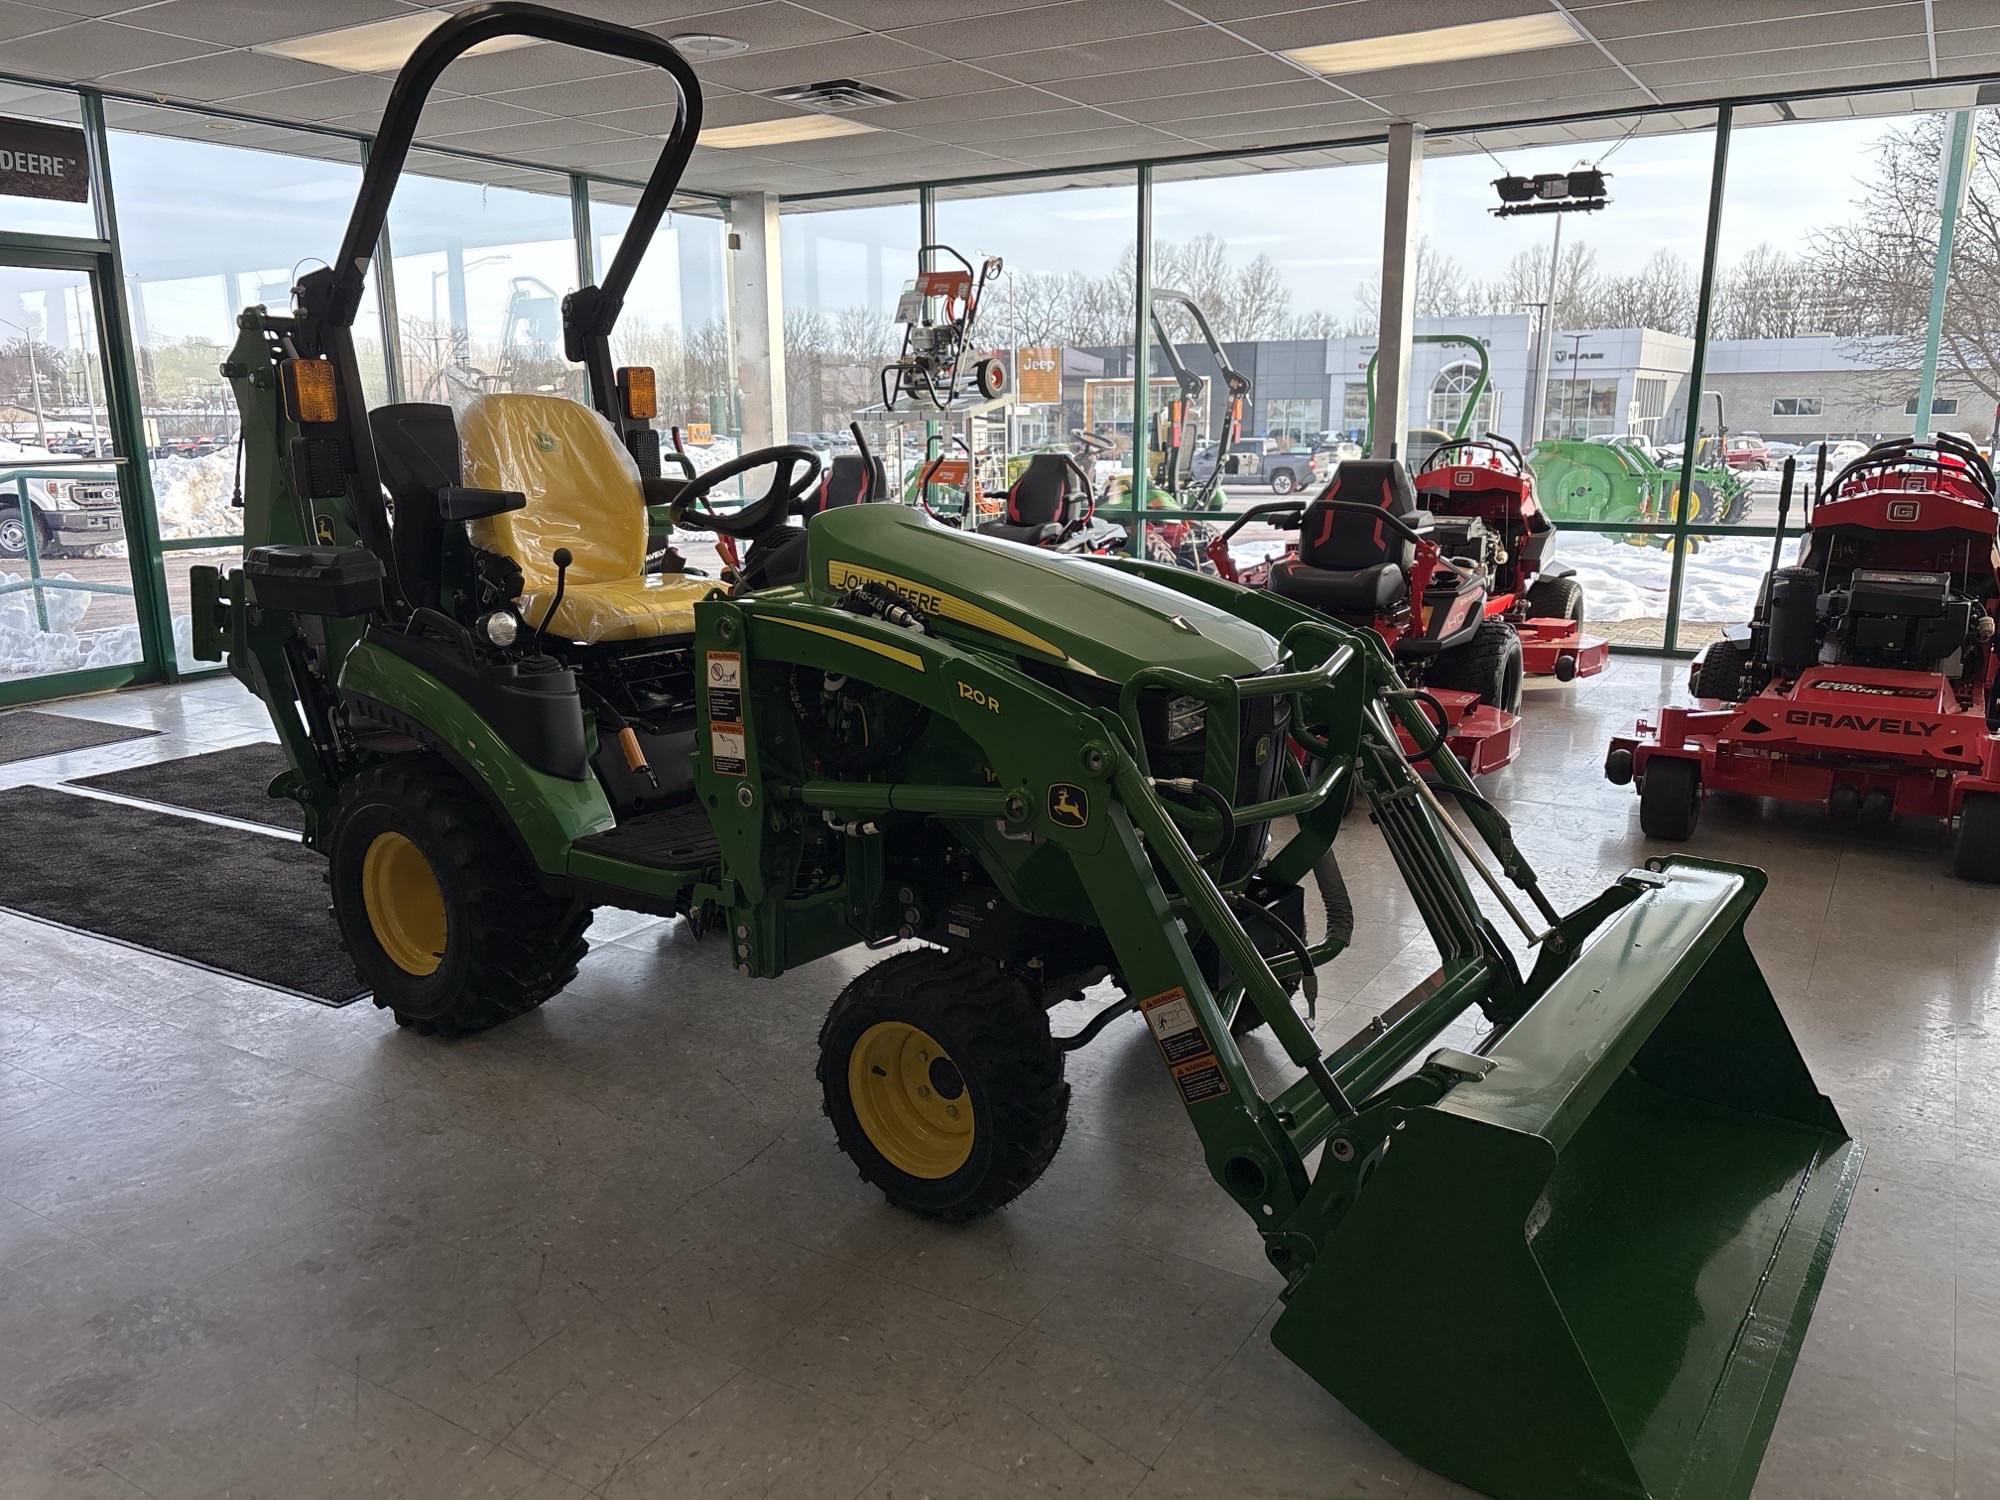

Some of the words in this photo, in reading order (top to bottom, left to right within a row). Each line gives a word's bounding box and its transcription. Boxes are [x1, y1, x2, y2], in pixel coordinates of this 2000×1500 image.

[1023, 357, 1056, 372] Jeep
[1447, 612, 1465, 630] HD
[957, 680, 986, 705] 120
[988, 696, 1000, 714] R
[717, 725, 743, 733] WARNING
[1785, 710, 1943, 737] GRAVELY
[1153, 990, 1180, 1006] WARNING
[1185, 1059, 1213, 1073] WARNING
